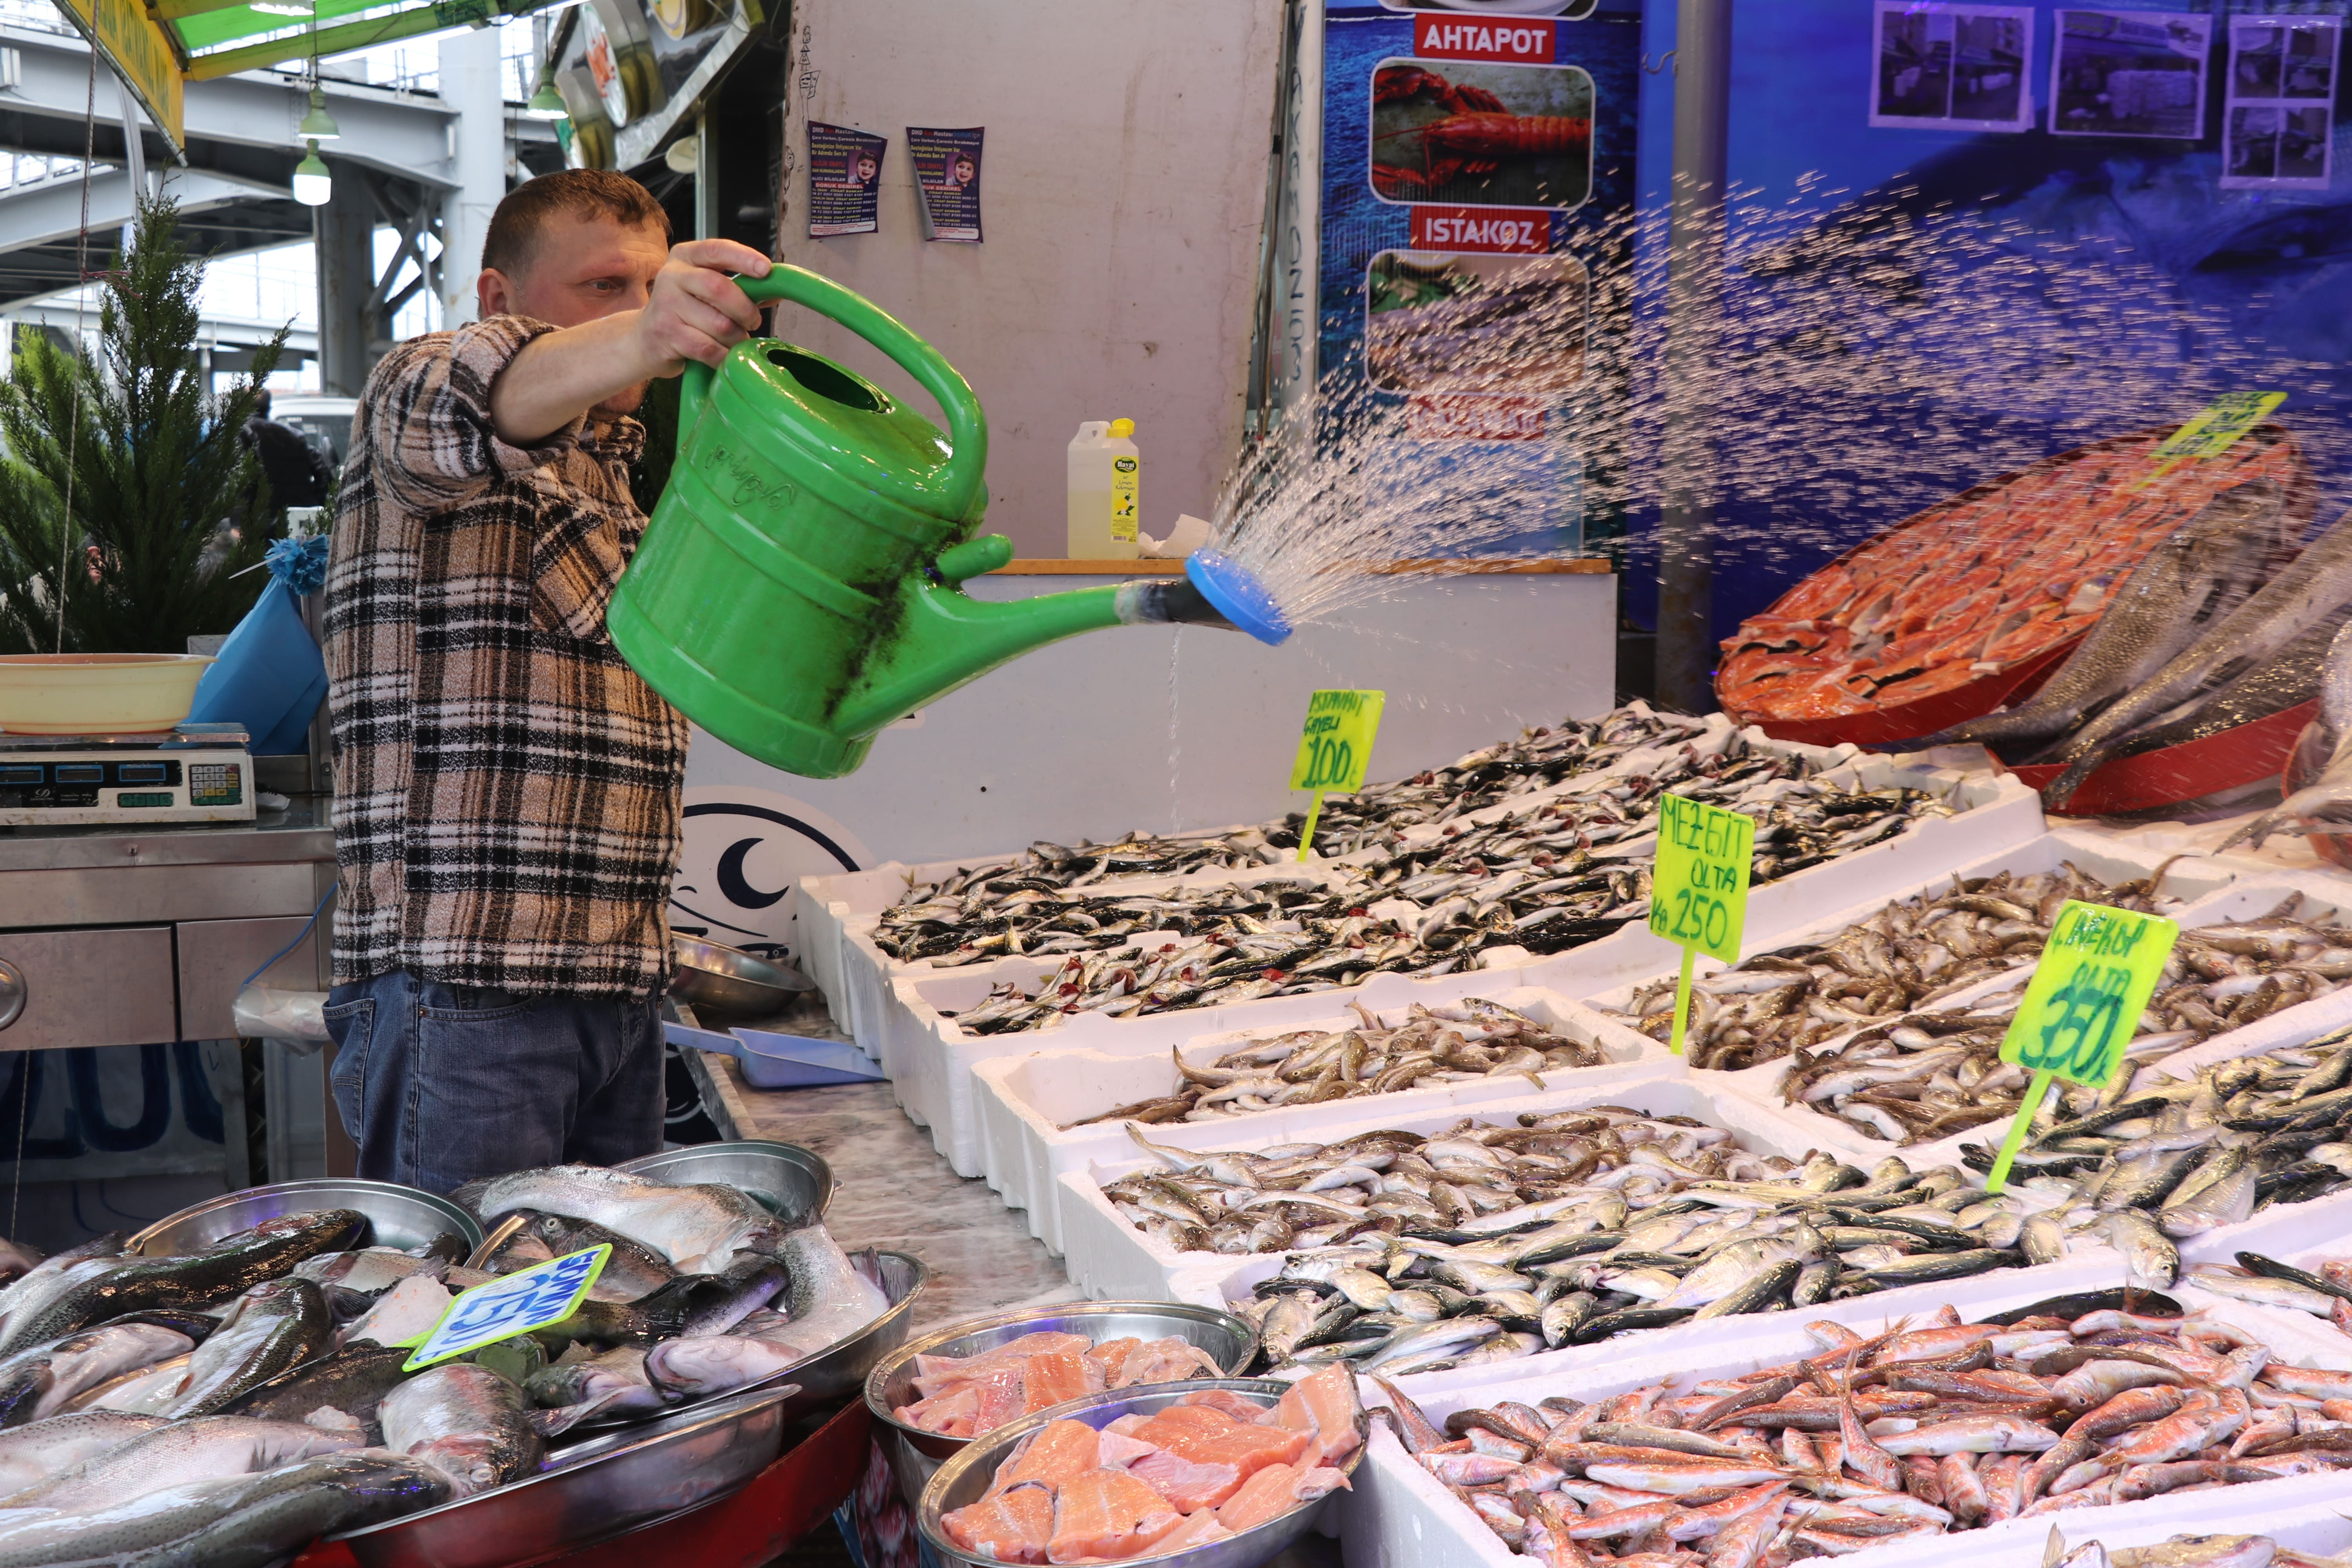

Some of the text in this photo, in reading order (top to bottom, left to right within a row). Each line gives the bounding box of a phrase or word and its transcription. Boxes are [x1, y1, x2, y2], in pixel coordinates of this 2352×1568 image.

[1423, 24, 1548, 54] AHTAPOT
[1426, 217, 1534, 245] ISTAKOZ
[1302, 736, 1352, 788] 100
[1691, 858, 1737, 893] OLTA
[1670, 888, 1727, 949] 250
[2019, 985, 2124, 1078] 350
[523, 1250, 600, 1325] SOMON
